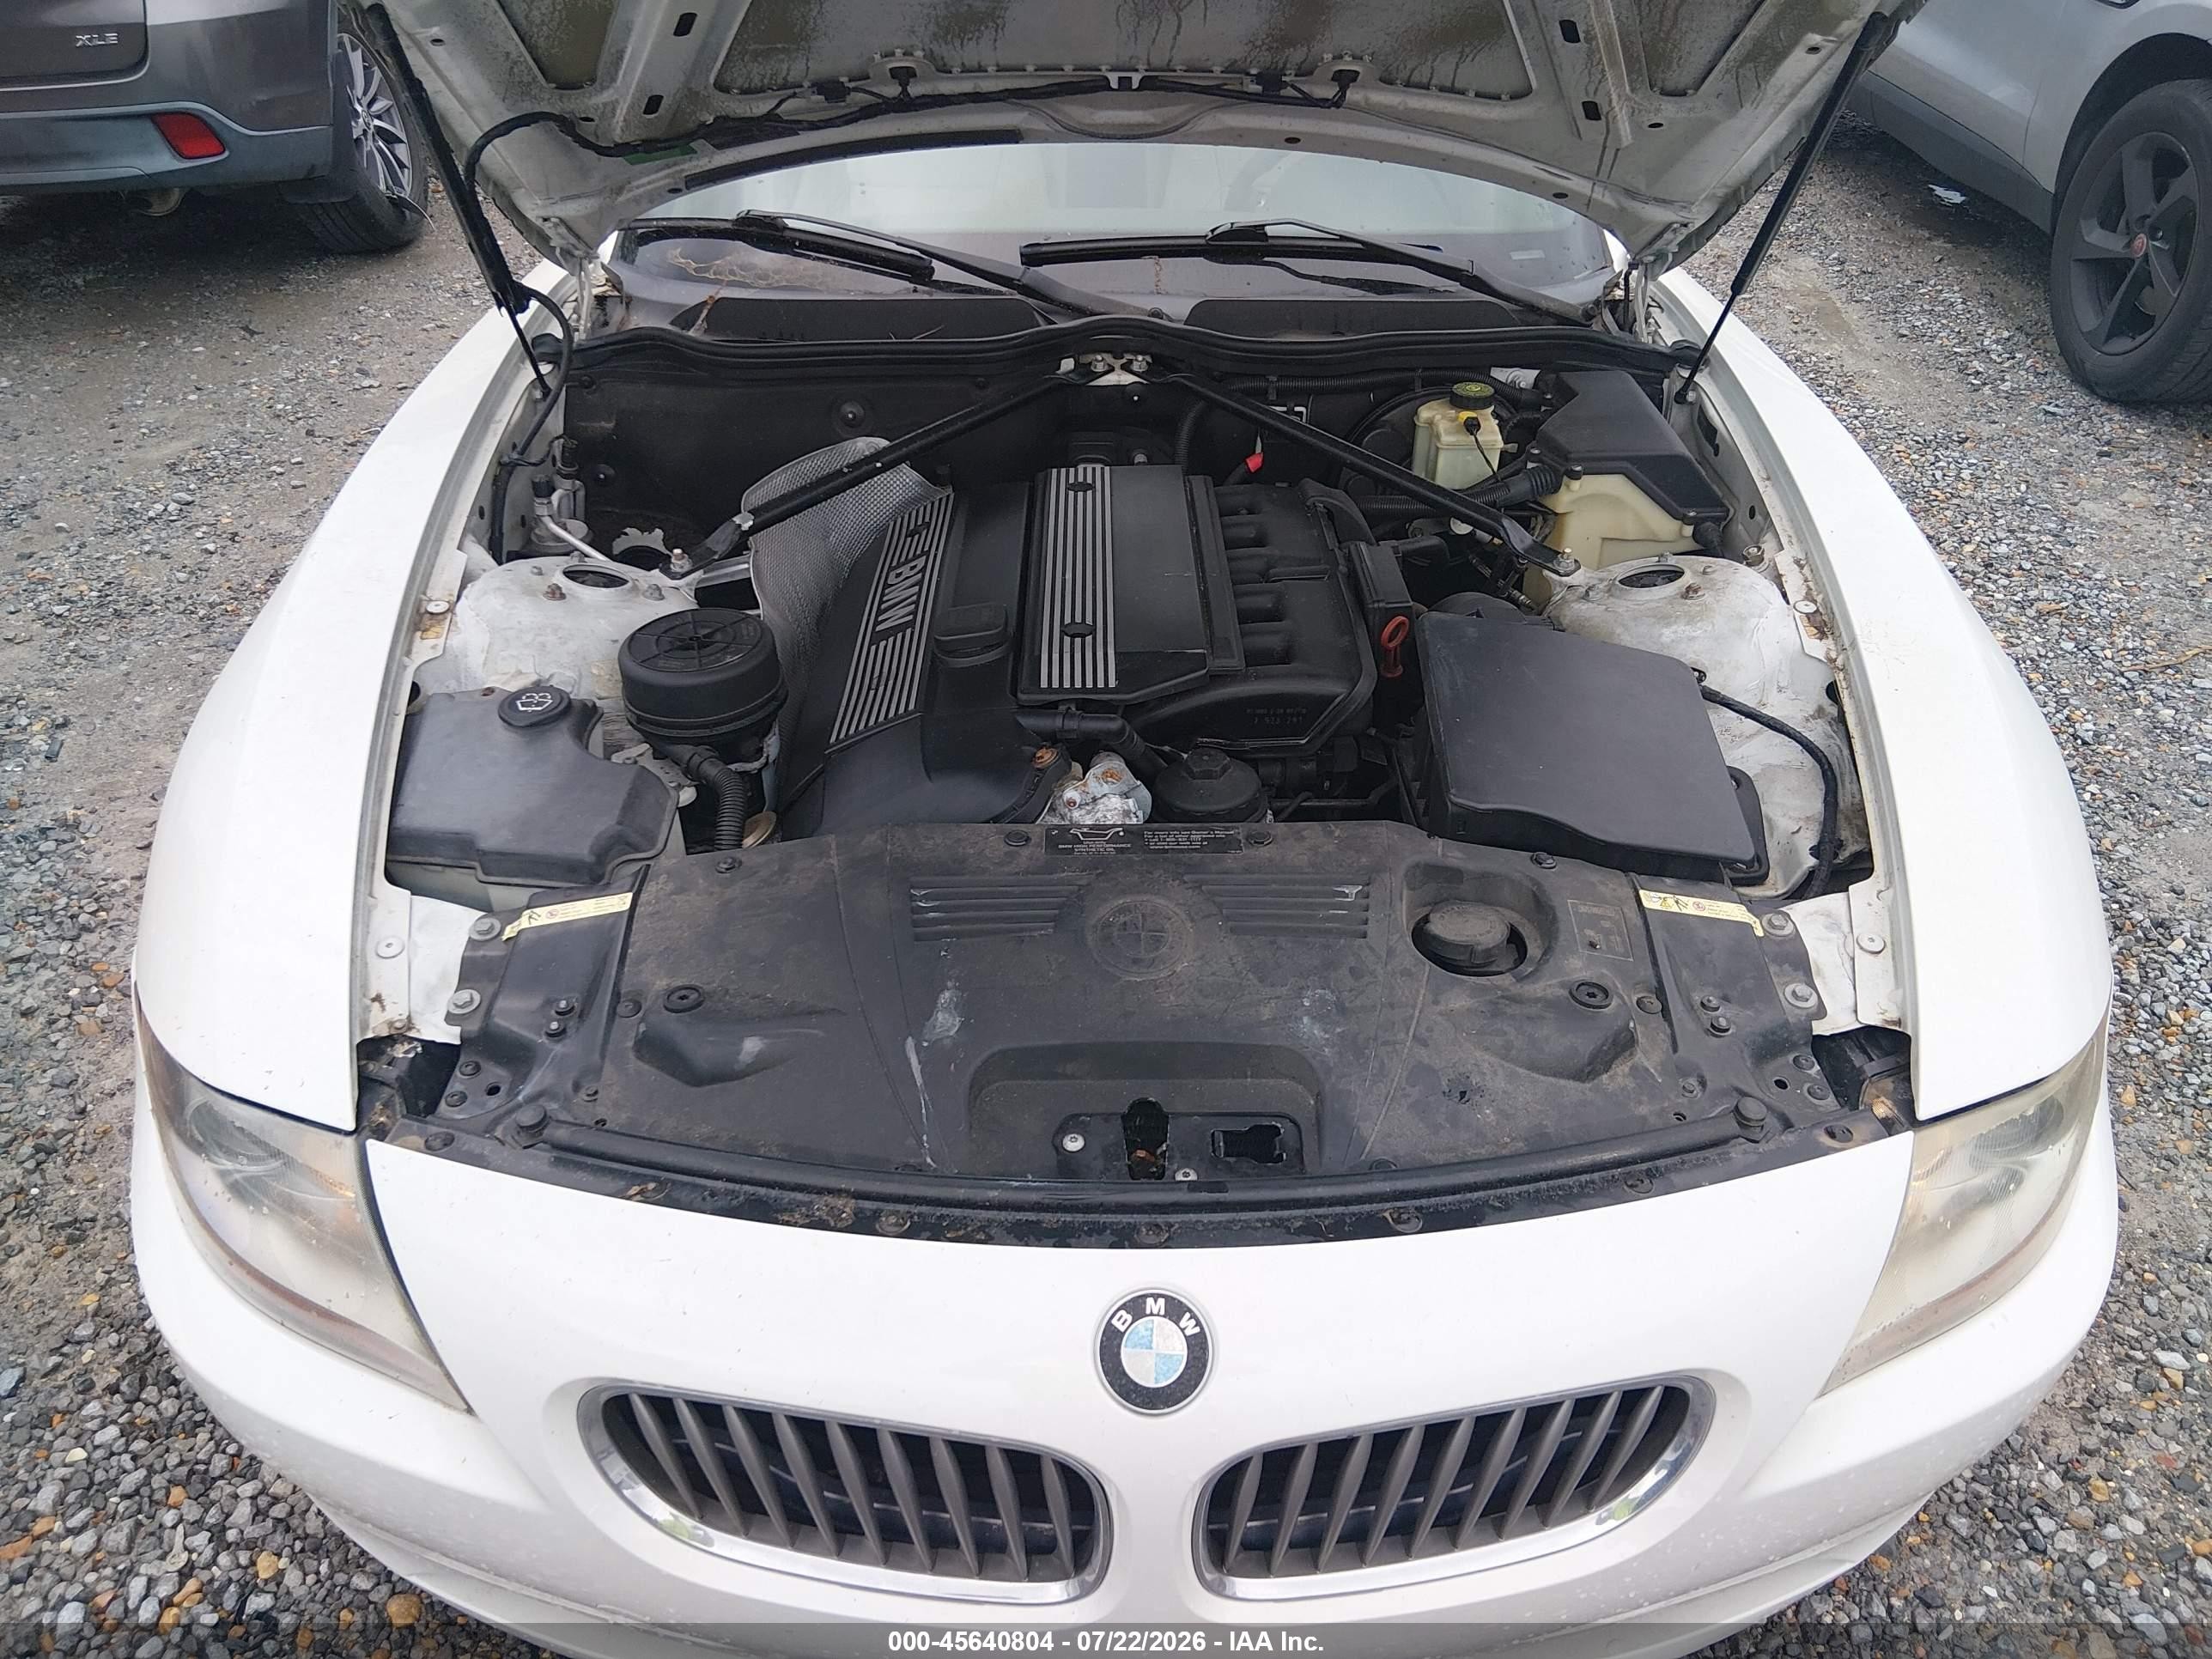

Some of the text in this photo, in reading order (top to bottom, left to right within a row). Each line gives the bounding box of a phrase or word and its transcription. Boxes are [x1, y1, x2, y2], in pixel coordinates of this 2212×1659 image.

[76, 33, 118, 46] XLE
[875, 555, 927, 632] BMW
[1110, 1297, 1200, 1336] BMW
